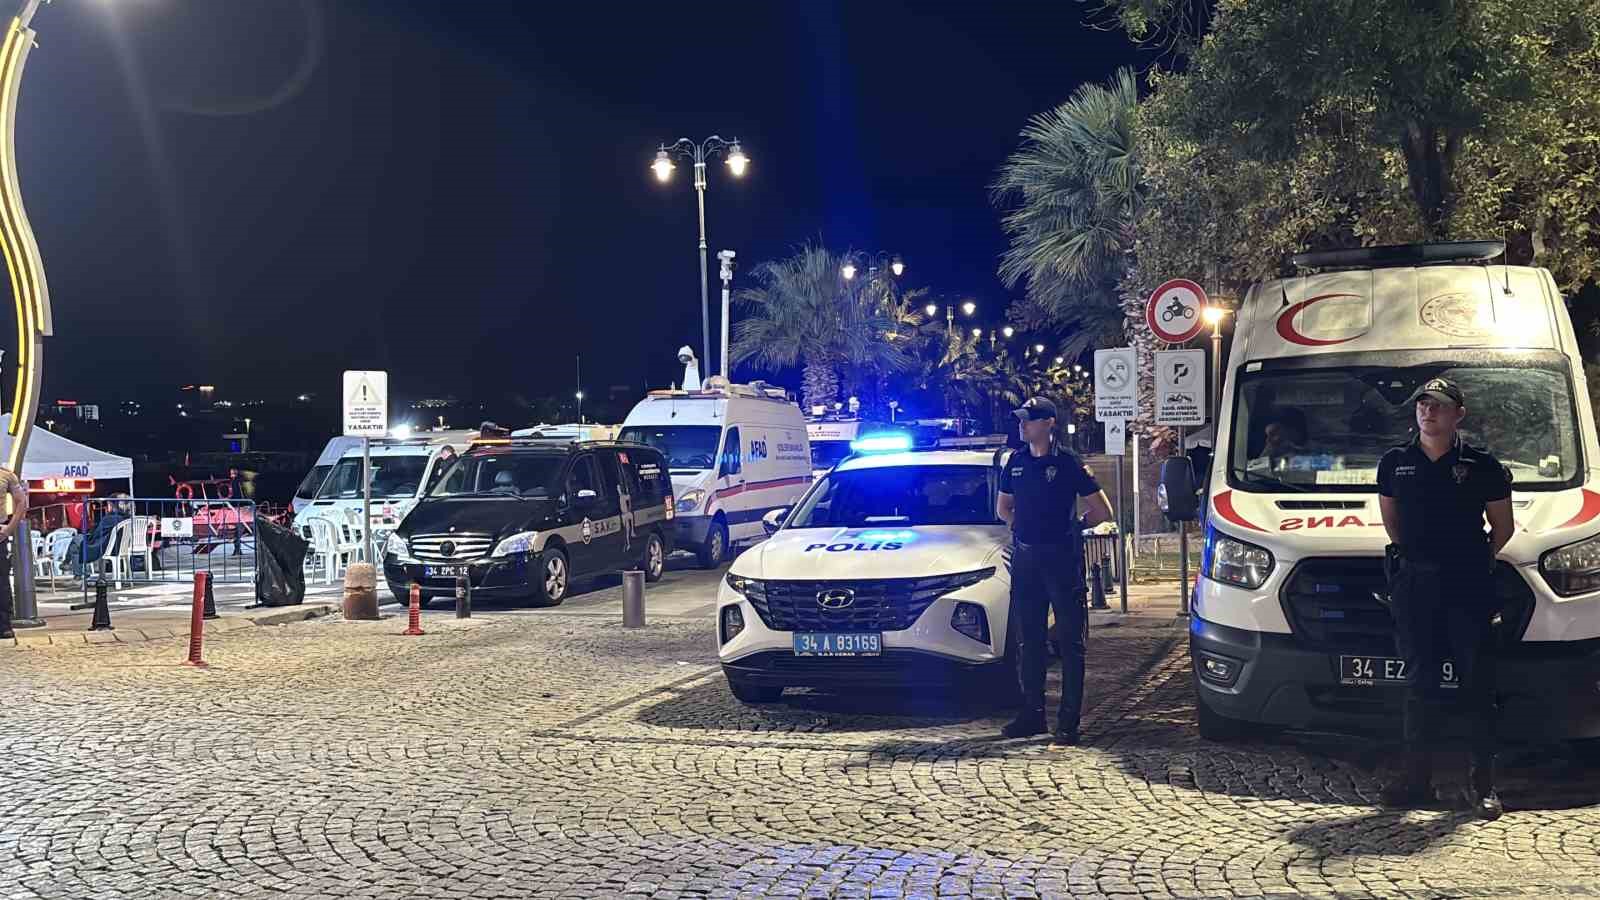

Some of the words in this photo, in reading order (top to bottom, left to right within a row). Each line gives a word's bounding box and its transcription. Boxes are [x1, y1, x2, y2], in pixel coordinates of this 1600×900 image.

[750, 439, 768, 459] AFAD
[64, 465, 89, 477] AFAD
[429, 566, 438, 576] 34
[441, 566, 455, 575] ZPC
[459, 566, 468, 576] 12
[802, 635, 818, 650] 34
[823, 635, 830, 650] A
[837, 635, 878, 651] 83169
[1352, 658, 1374, 678] 34
[1384, 660, 1406, 679] EZ
